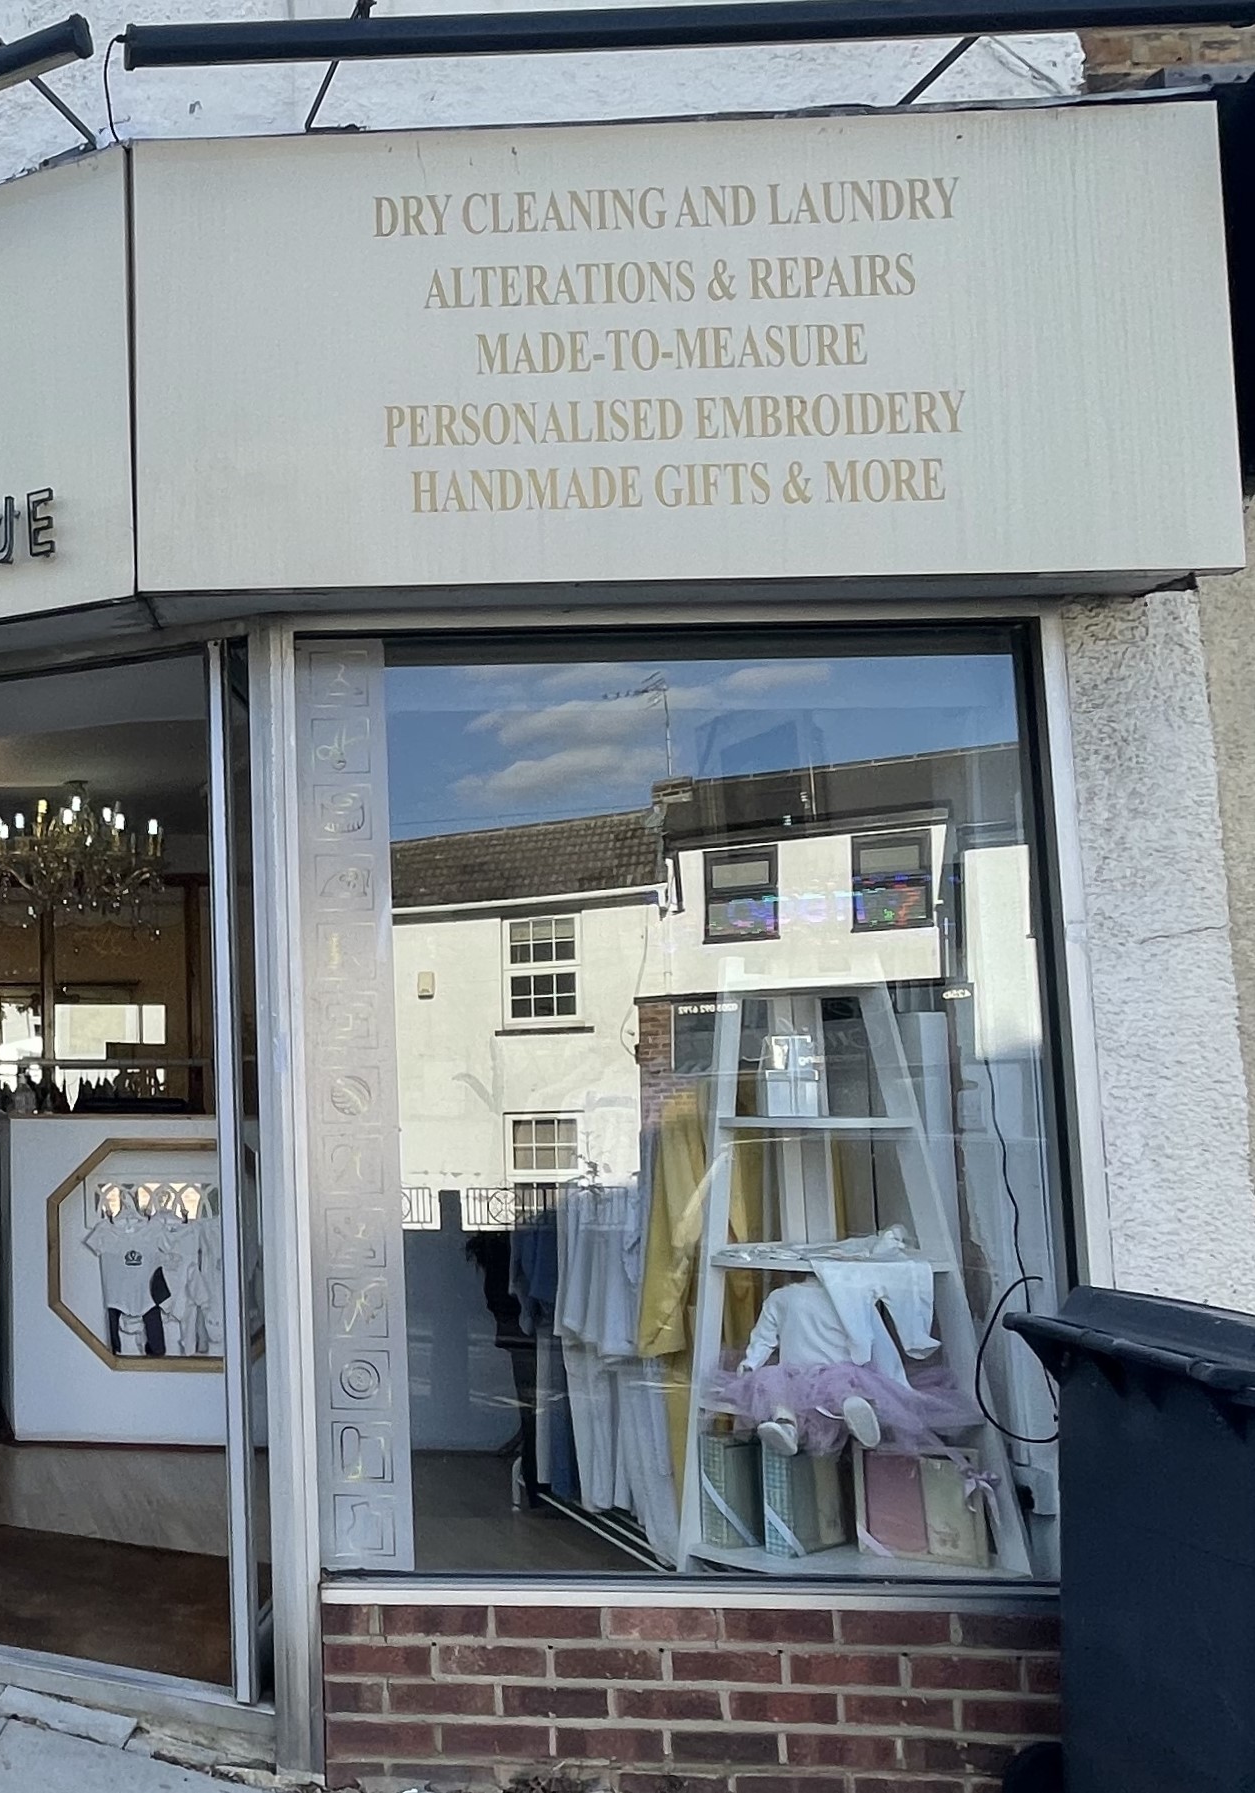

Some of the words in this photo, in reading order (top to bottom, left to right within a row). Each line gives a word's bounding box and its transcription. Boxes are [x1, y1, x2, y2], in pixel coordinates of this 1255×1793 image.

[373, 194, 453, 238] DRY
[461, 186, 668, 235] CLEANING
[675, 184, 757, 230] AND
[767, 176, 959, 227] LAUNDRY
[423, 259, 696, 310] ALTERATIONS
[707, 258, 737, 302] &
[749, 253, 917, 299] REPAIRS
[476, 323, 868, 375] MADE-TO-MEASURE
[383, 398, 684, 448] PERSONALISED
[694, 390, 965, 440] EMBROIDERY
[411, 465, 643, 513] HANDMADE
[654, 460, 770, 508] GIFTS
[782, 460, 813, 505] &
[824, 458, 946, 503] MORE
